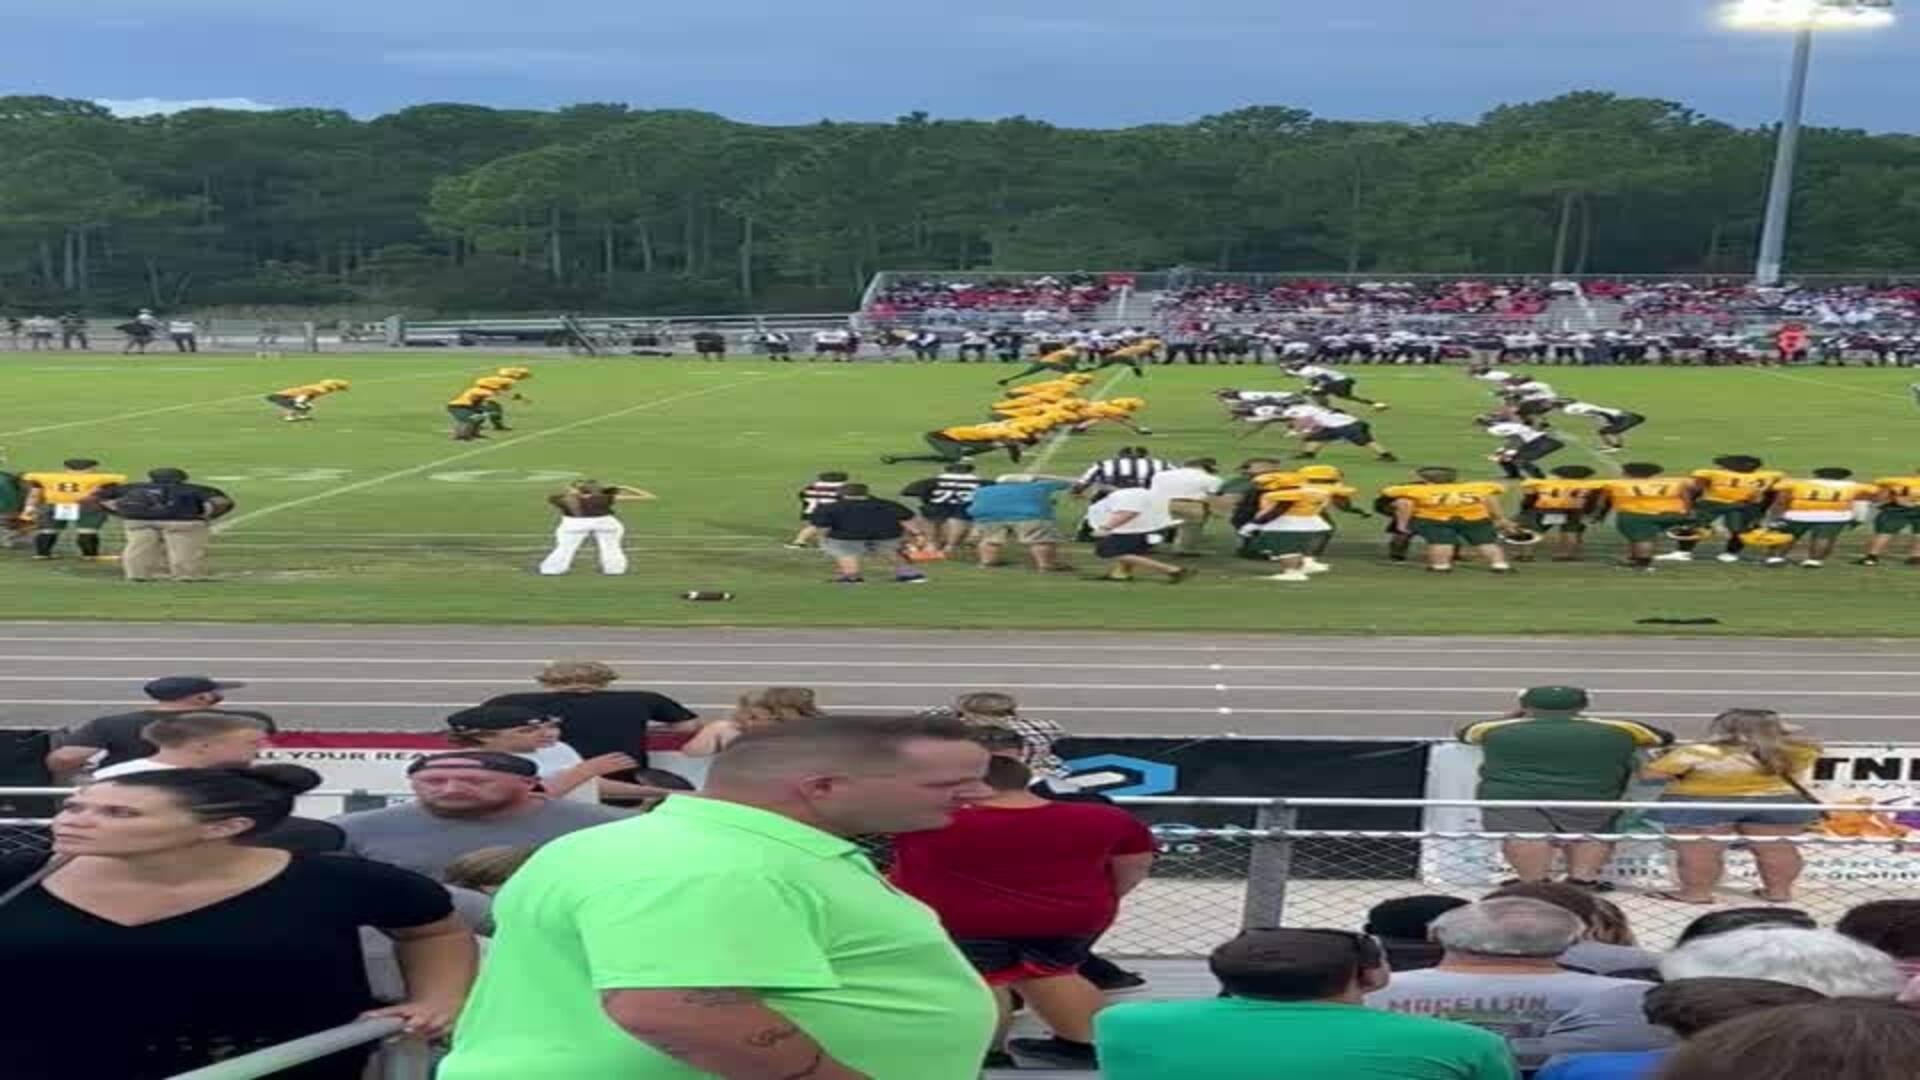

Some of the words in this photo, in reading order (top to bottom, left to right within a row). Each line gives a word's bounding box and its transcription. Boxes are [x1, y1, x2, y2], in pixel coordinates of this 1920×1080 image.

[57, 481, 79, 493] 8
[288, 751, 366, 761] YOUR
[1388, 996, 1547, 1014] MAGELLAN
